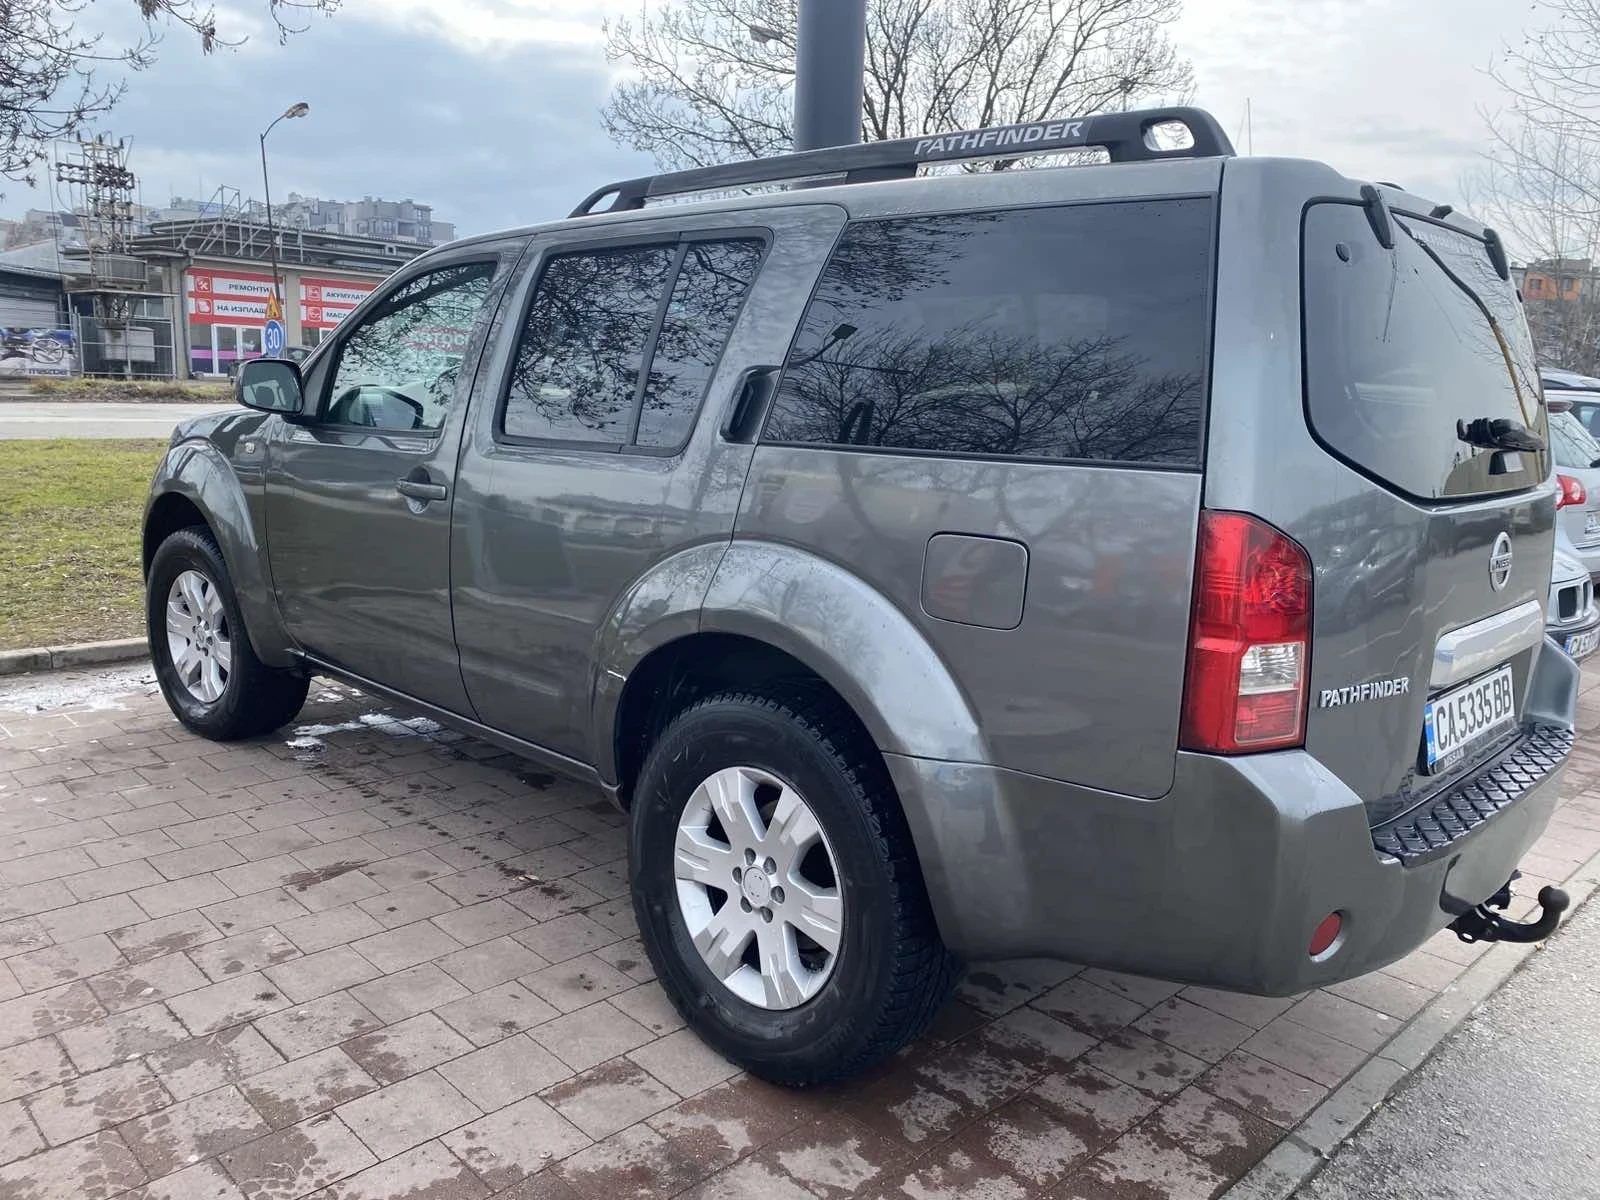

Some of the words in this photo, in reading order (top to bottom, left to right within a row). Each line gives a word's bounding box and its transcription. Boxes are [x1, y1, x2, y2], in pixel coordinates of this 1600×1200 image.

[914, 121, 1084, 156] PATHFINDER
[228, 283, 270, 293] РЕМОНТИ
[326, 291, 368, 300] АКУМУЛАТ
[231, 305, 266, 314] ИЗПЛАЩ
[267, 327, 280, 349] 30
[1319, 676, 1410, 708] PATHFINDER
